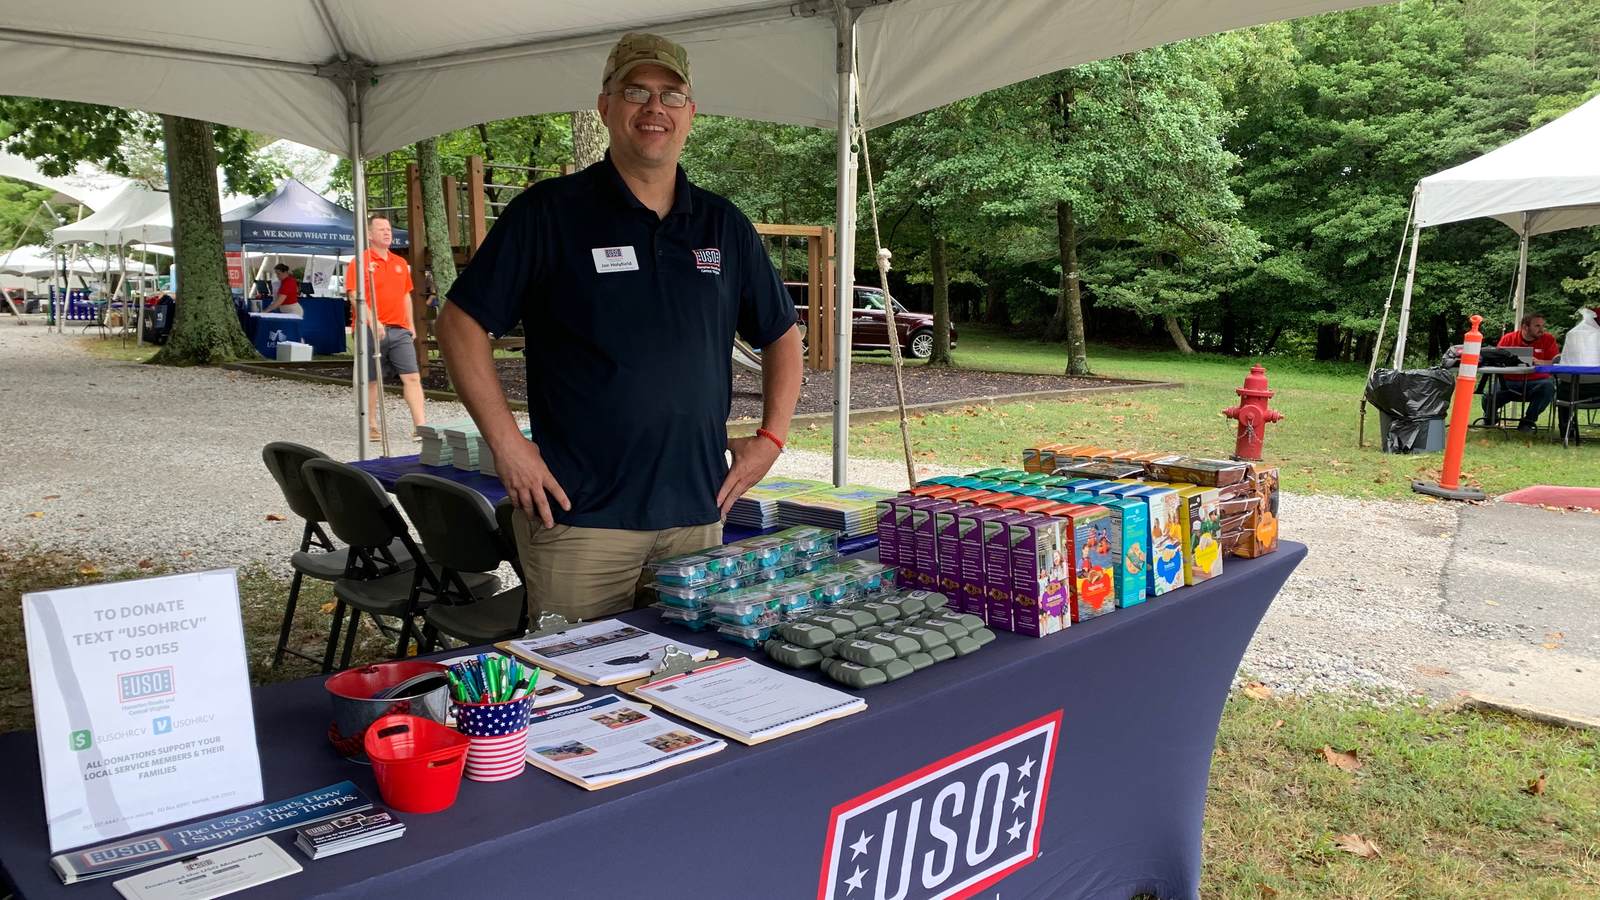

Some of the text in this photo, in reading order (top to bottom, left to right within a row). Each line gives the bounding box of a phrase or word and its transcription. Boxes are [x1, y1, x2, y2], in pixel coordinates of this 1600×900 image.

[277, 230, 302, 239] KNOW
[304, 231, 328, 240] WHAT
[700, 250, 716, 263] USO
[94, 599, 185, 622] TO DONATE
[73, 629, 115, 646] TEXT
[109, 641, 179, 662] TO 50155
[130, 672, 162, 696] USO
[173, 713, 215, 729] USOHRCV
[84, 769, 113, 781] LOCAL
[114, 760, 150, 775] SERVICE
[151, 752, 192, 767] MEMBERS
[201, 745, 225, 756] THEIR
[86, 735, 221, 770] ALL DONATIONS SUPPORT YOUR
[138, 765, 177, 780] FAMILIES
[174, 826, 210, 839] The
[303, 790, 341, 804] How
[180, 794, 358, 846] I Support The Troops.
[874, 761, 1010, 900] USO
[102, 843, 150, 861] USO
